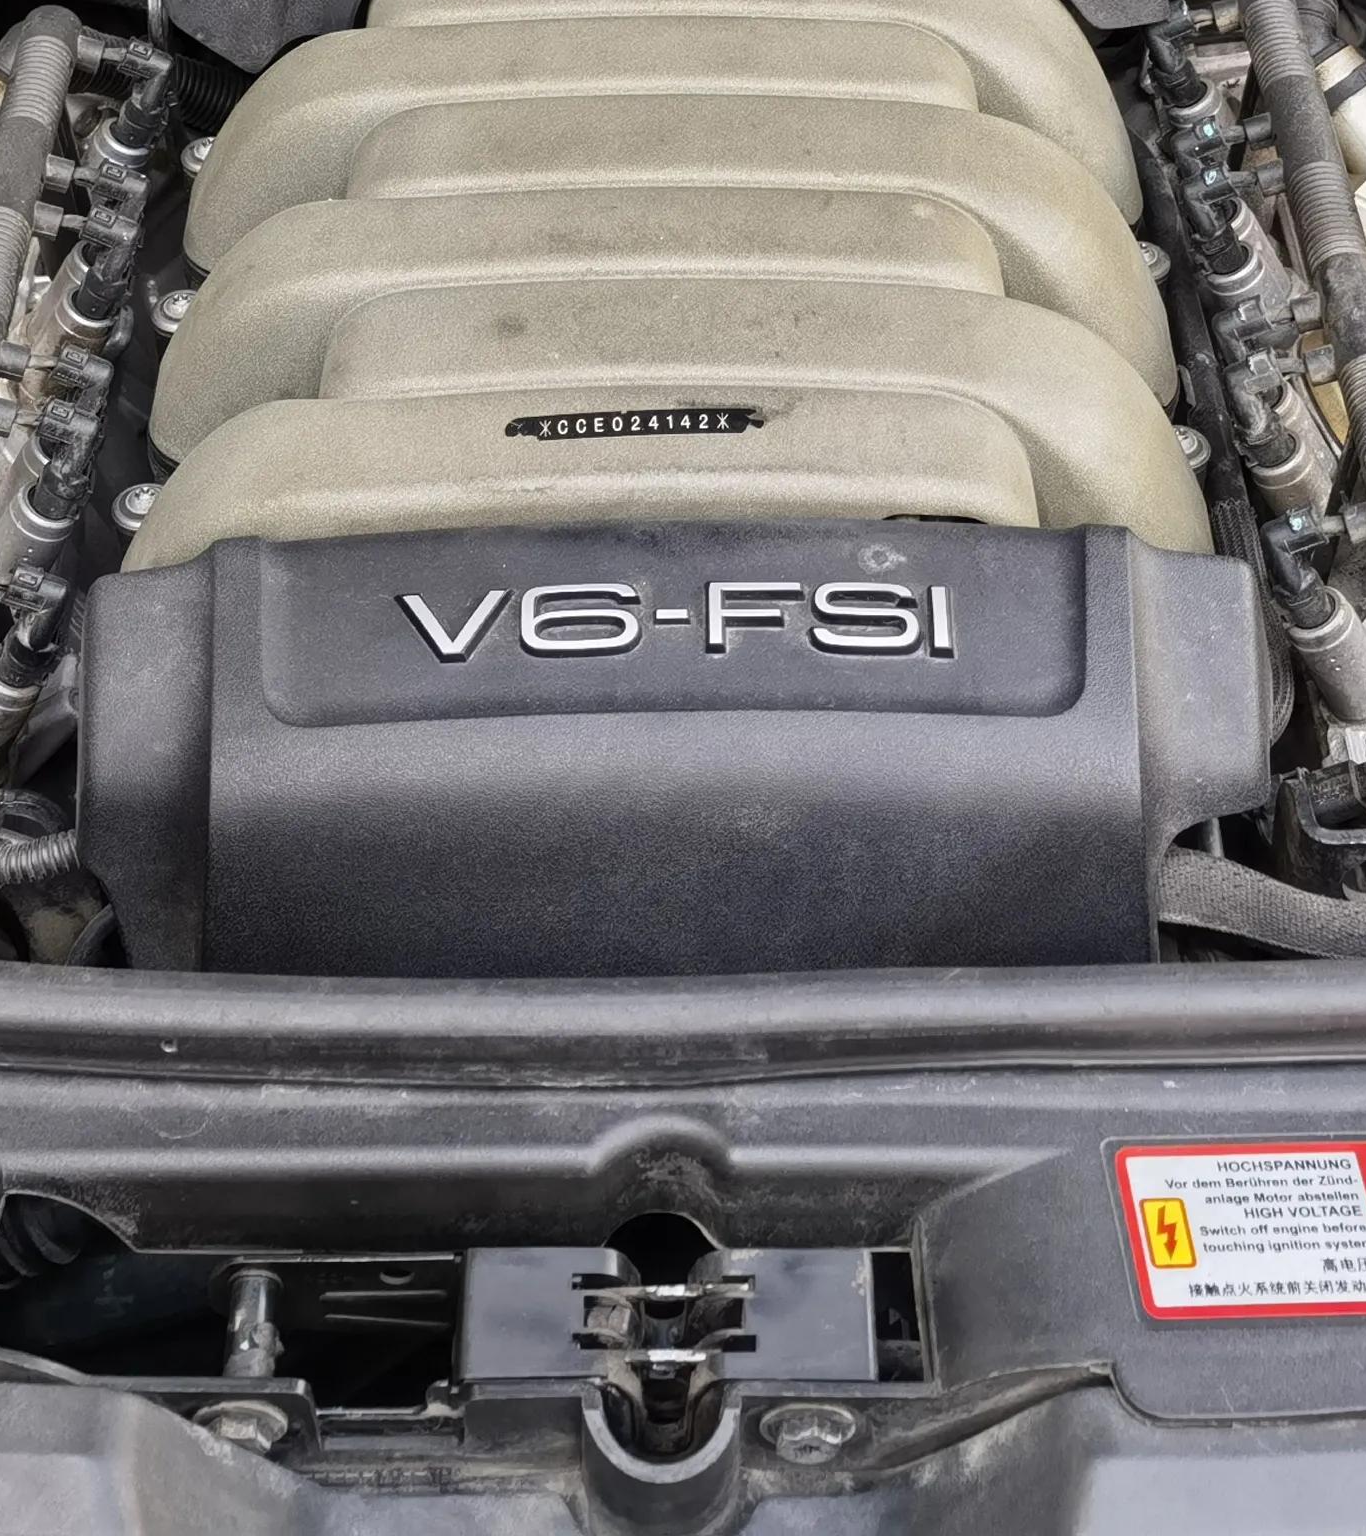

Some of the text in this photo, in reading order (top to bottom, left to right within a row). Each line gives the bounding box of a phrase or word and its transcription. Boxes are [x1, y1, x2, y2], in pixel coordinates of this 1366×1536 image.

[395, 581, 956, 664] V6-FSI
[1217, 1159, 1352, 1173] HOCHSPANNUNG
[1165, 1174, 1358, 1190] Vor dem Berühren der Zünd-
[1205, 1190, 1360, 1207] anlage Motor abstellen
[1244, 1205, 1364, 1219] HIGH VOLTAGE
[1200, 1222, 1366, 1237] Switch off engine before
[1203, 1240, 1265, 1254] touching
[1268, 1239, 1321, 1252] ignition
